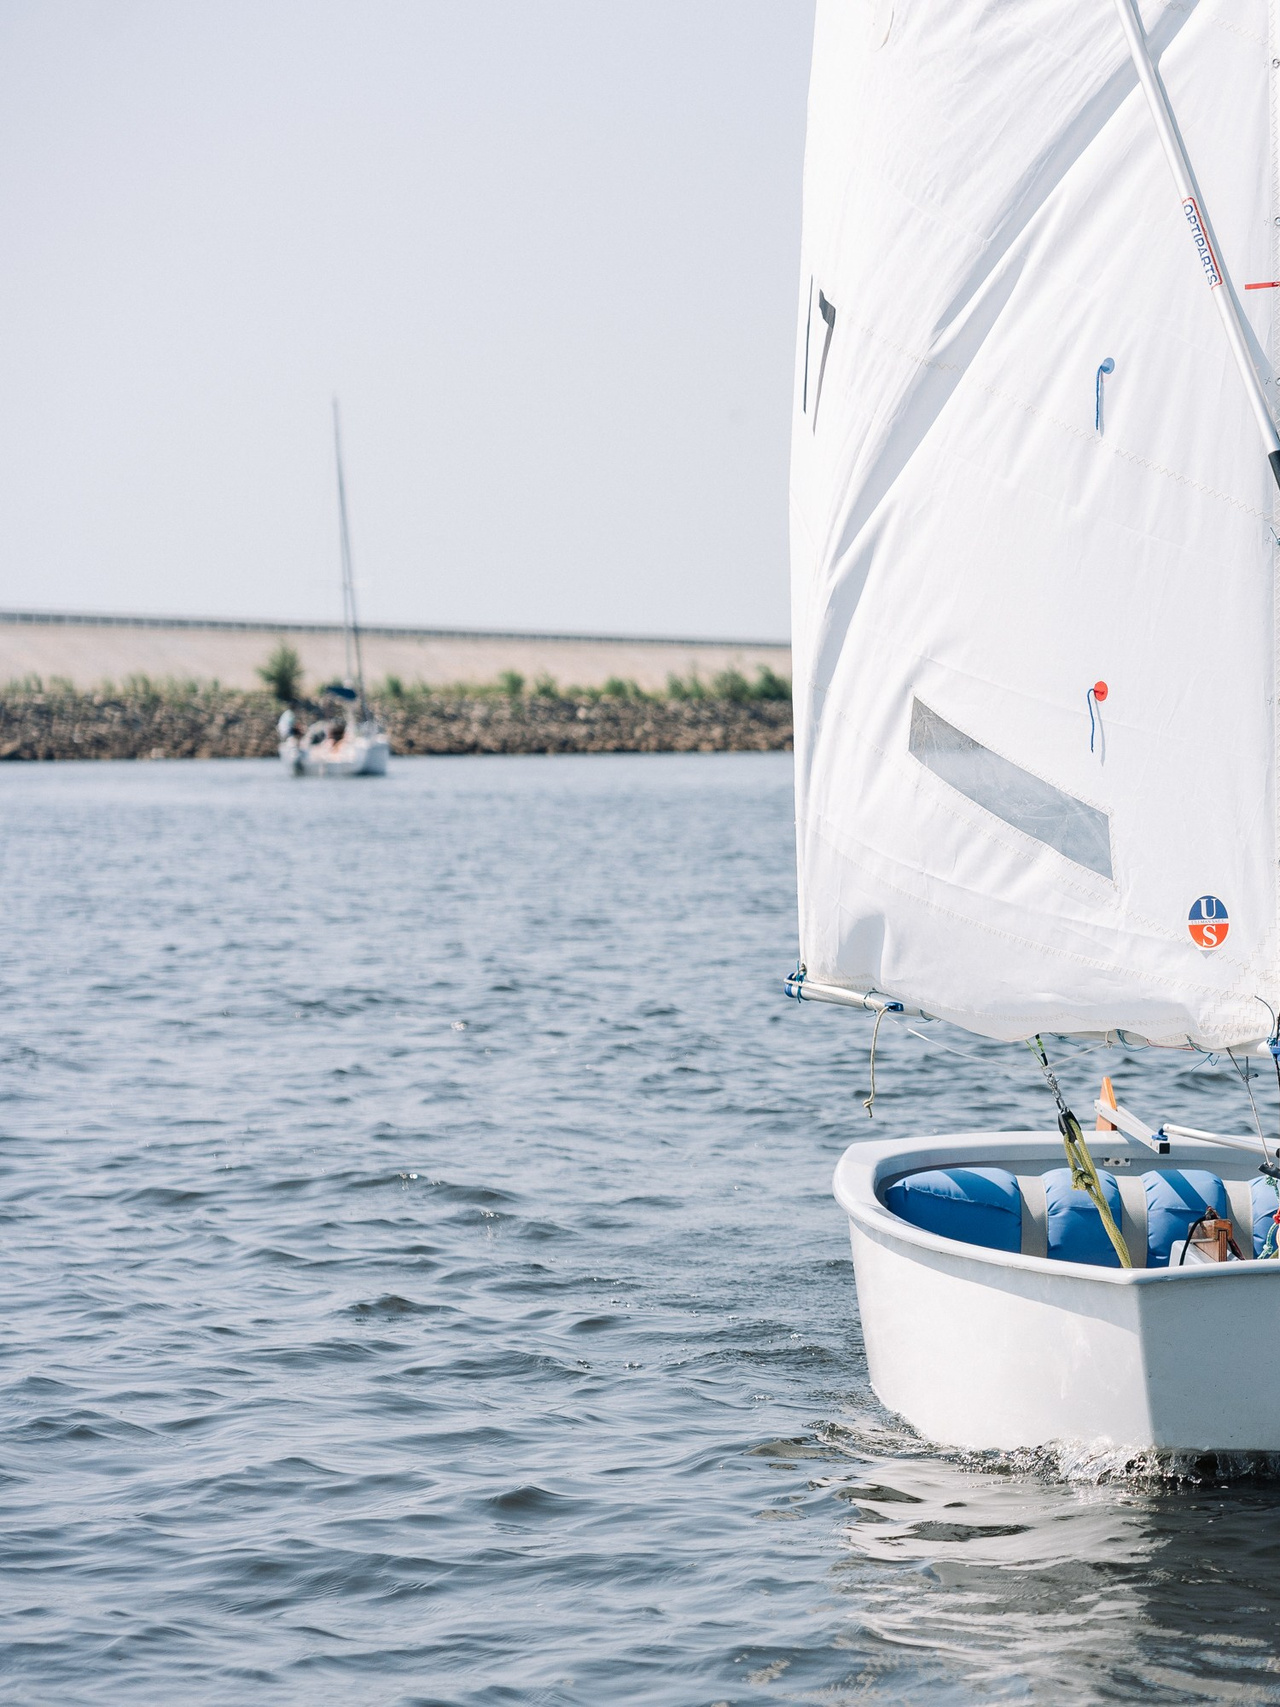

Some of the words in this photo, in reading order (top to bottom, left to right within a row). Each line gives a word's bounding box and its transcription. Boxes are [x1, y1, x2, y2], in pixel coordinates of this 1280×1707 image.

[1183, 204, 1218, 285] OPTIPARTS
[1199, 898, 1217, 918] U
[1202, 925, 1217, 946] S
